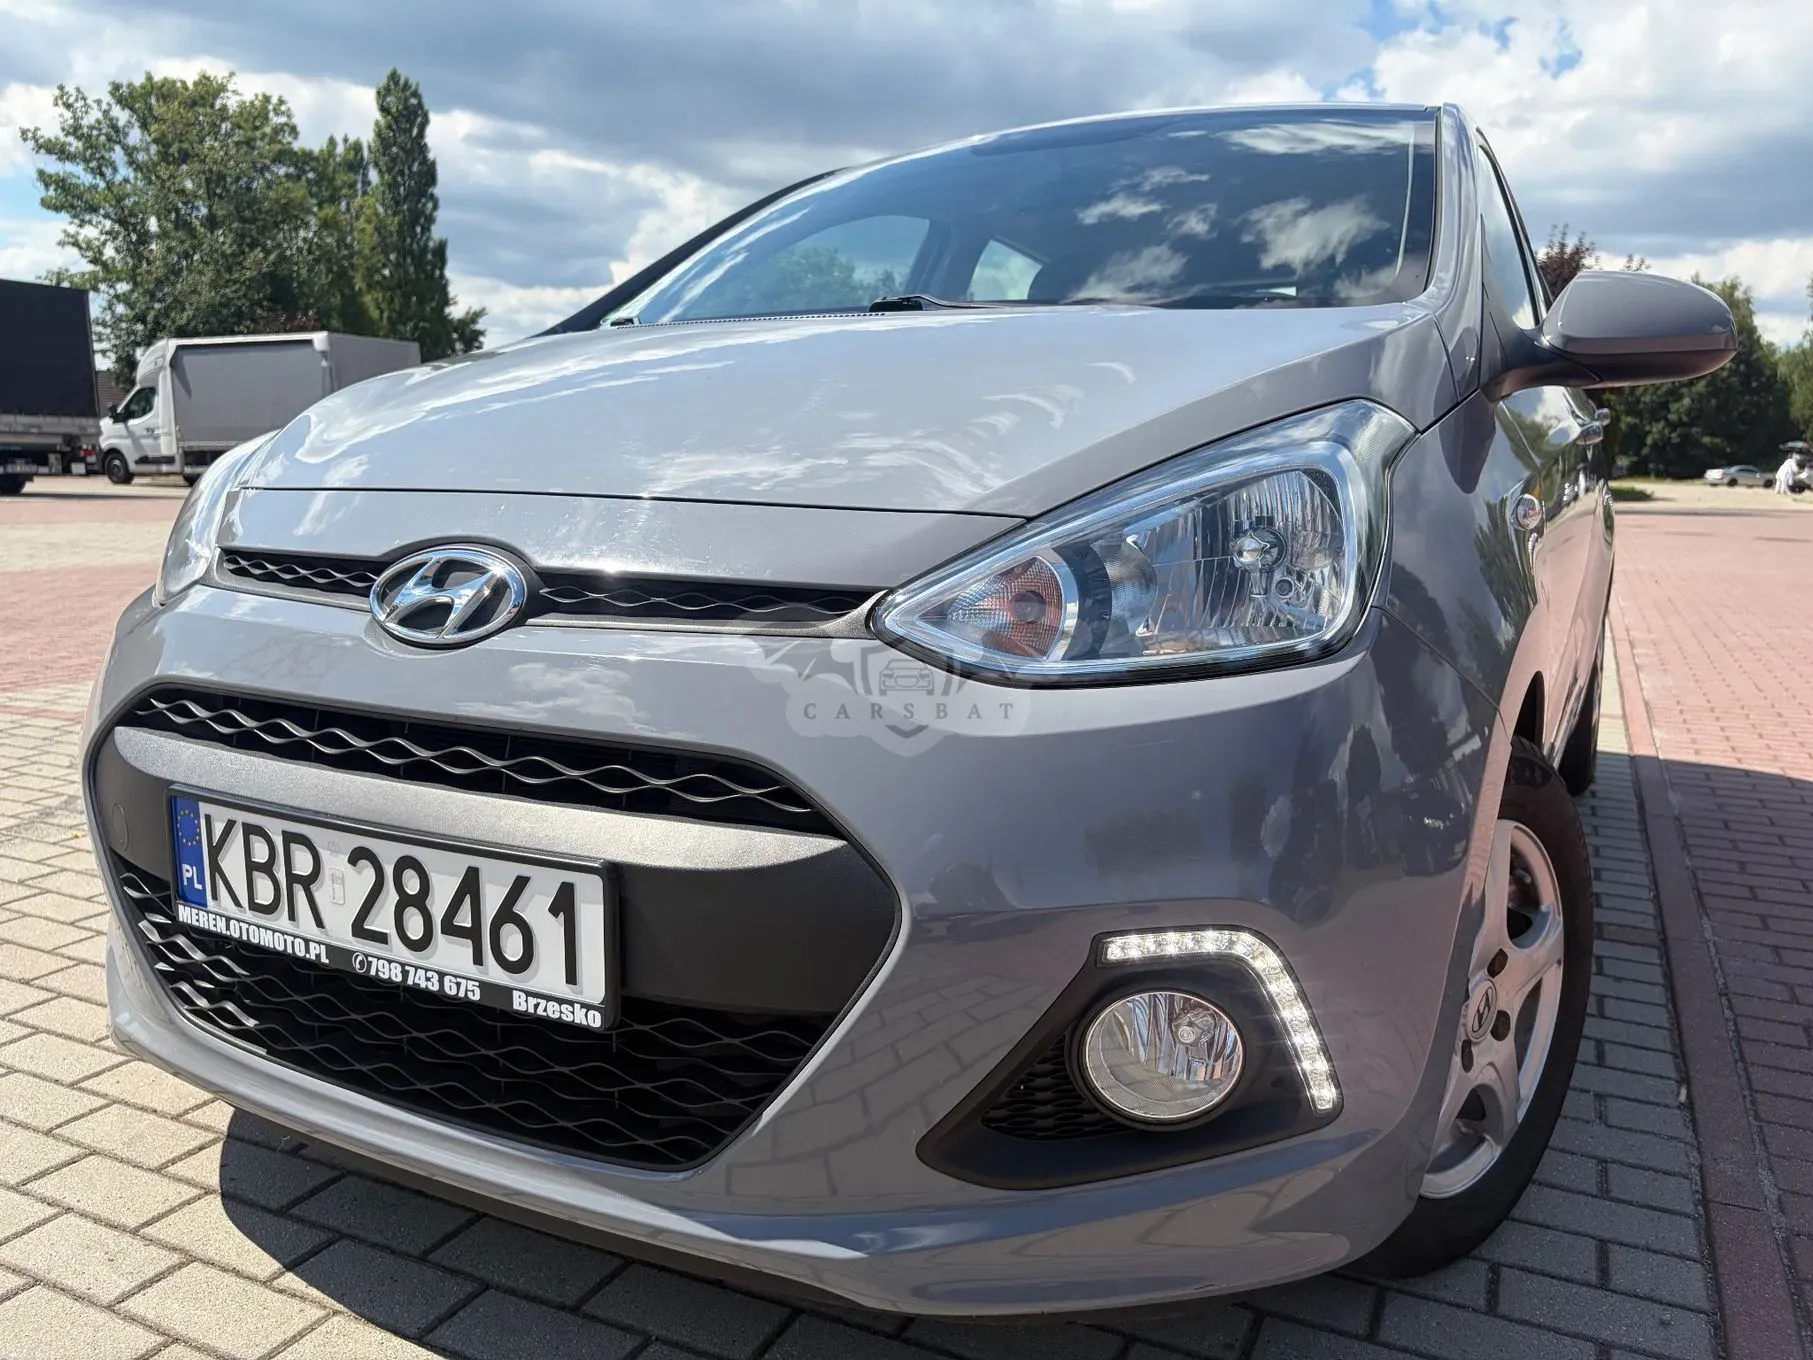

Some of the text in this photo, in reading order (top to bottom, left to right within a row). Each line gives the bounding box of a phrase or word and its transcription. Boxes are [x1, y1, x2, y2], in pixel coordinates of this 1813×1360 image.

[182, 863, 203, 890] PL
[204, 813, 579, 987] KBR 28461
[178, 906, 602, 1028] MEREN.OTOMOTO.PL 798 743 675 Brzesko
